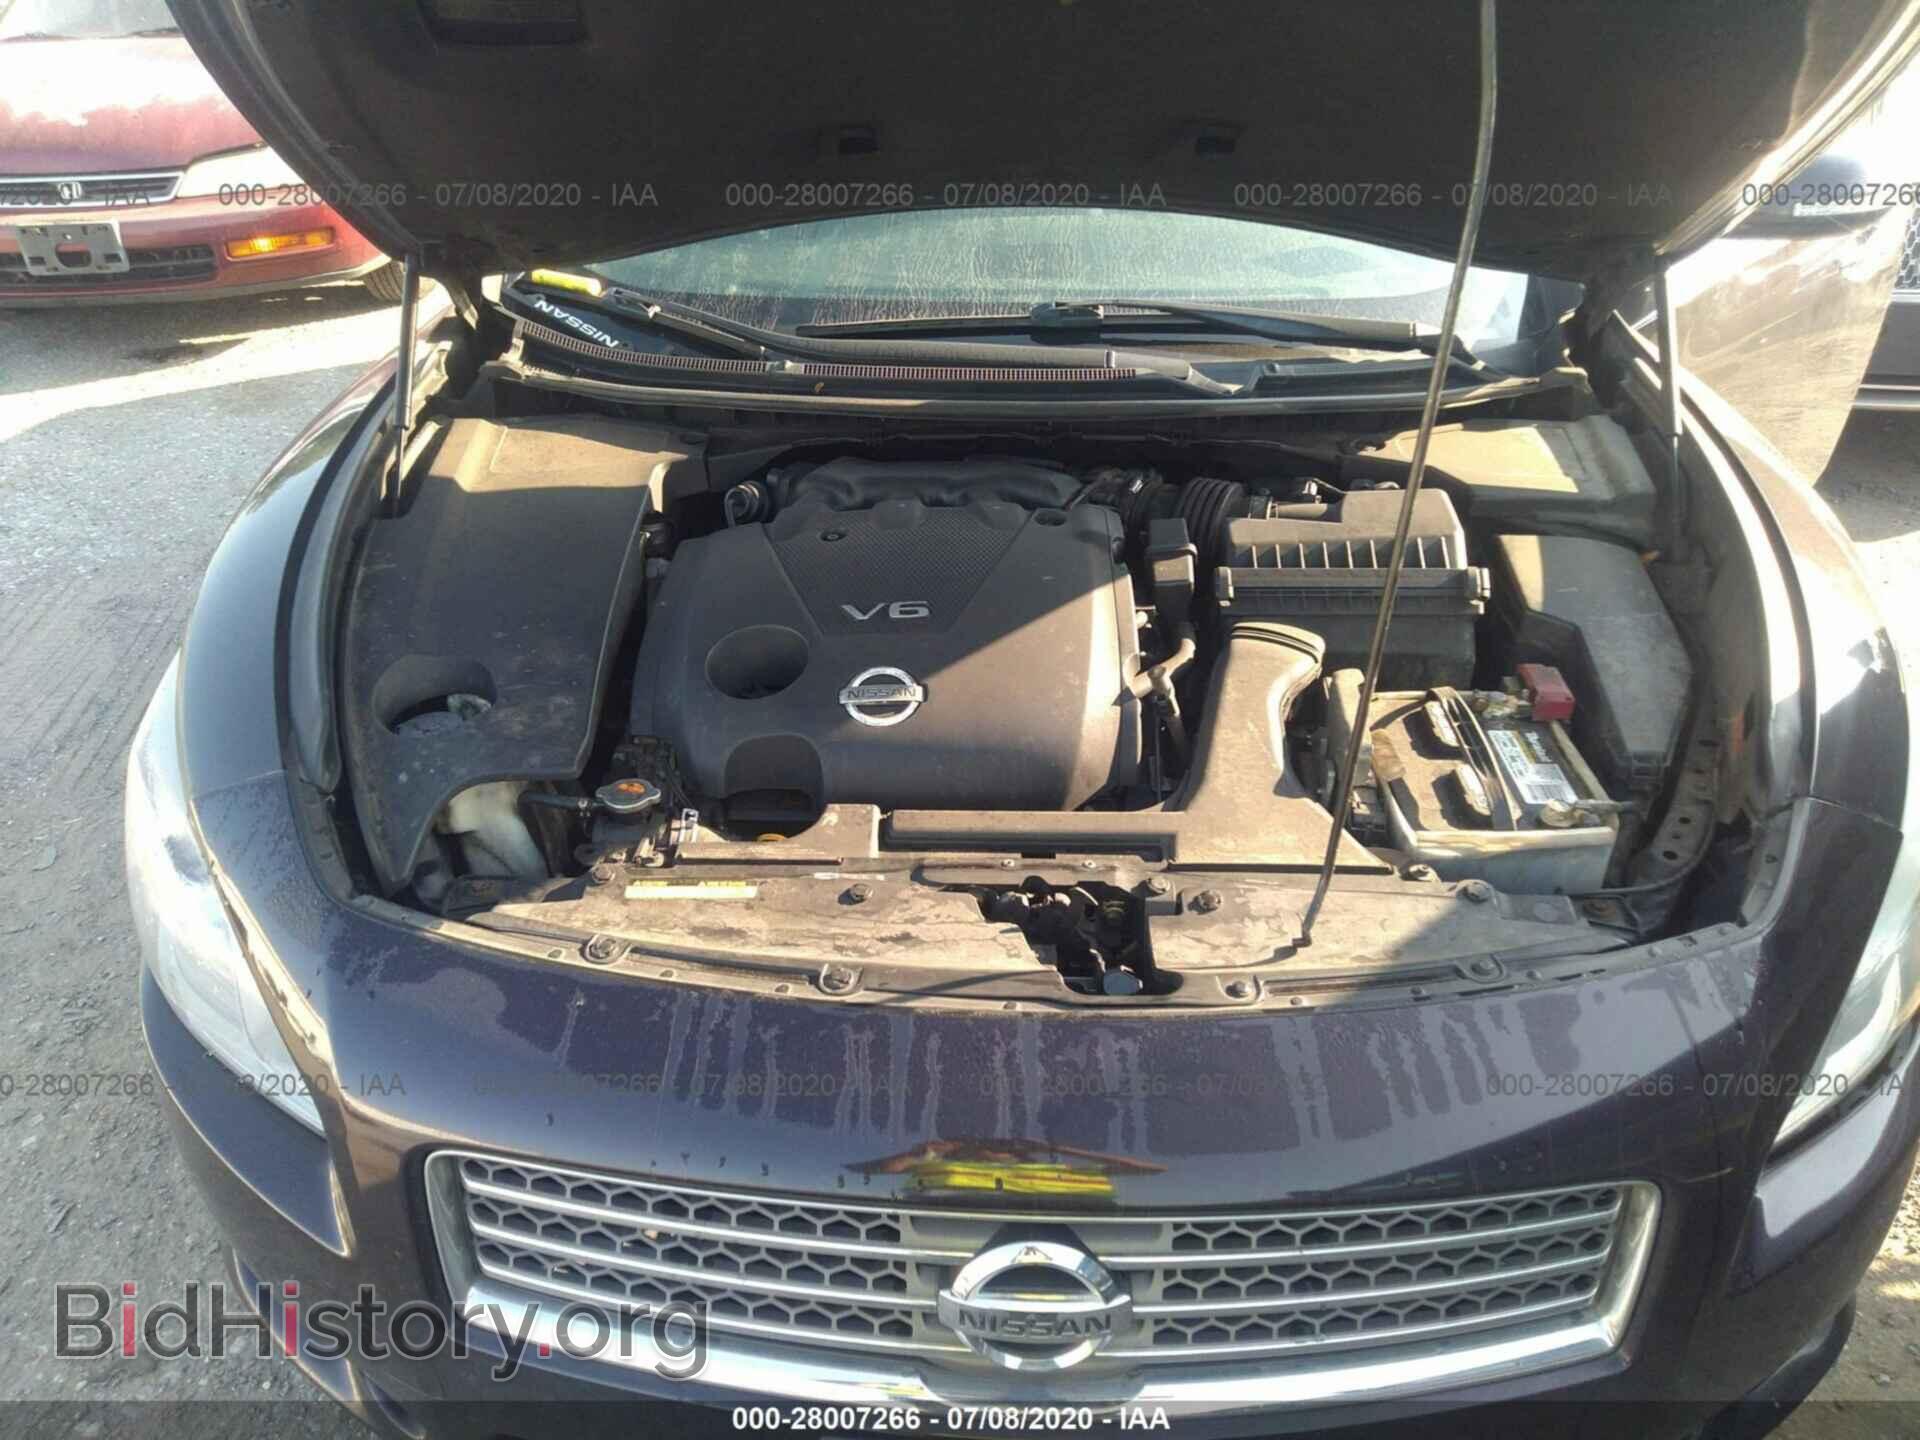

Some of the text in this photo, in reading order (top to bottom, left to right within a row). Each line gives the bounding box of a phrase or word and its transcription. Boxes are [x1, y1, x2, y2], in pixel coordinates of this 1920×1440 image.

[534, 300, 620, 348] NISSAN
[841, 600, 930, 620] V6
[847, 687, 917, 699] NISSAN
[958, 1308, 1112, 1337] NISSAN
